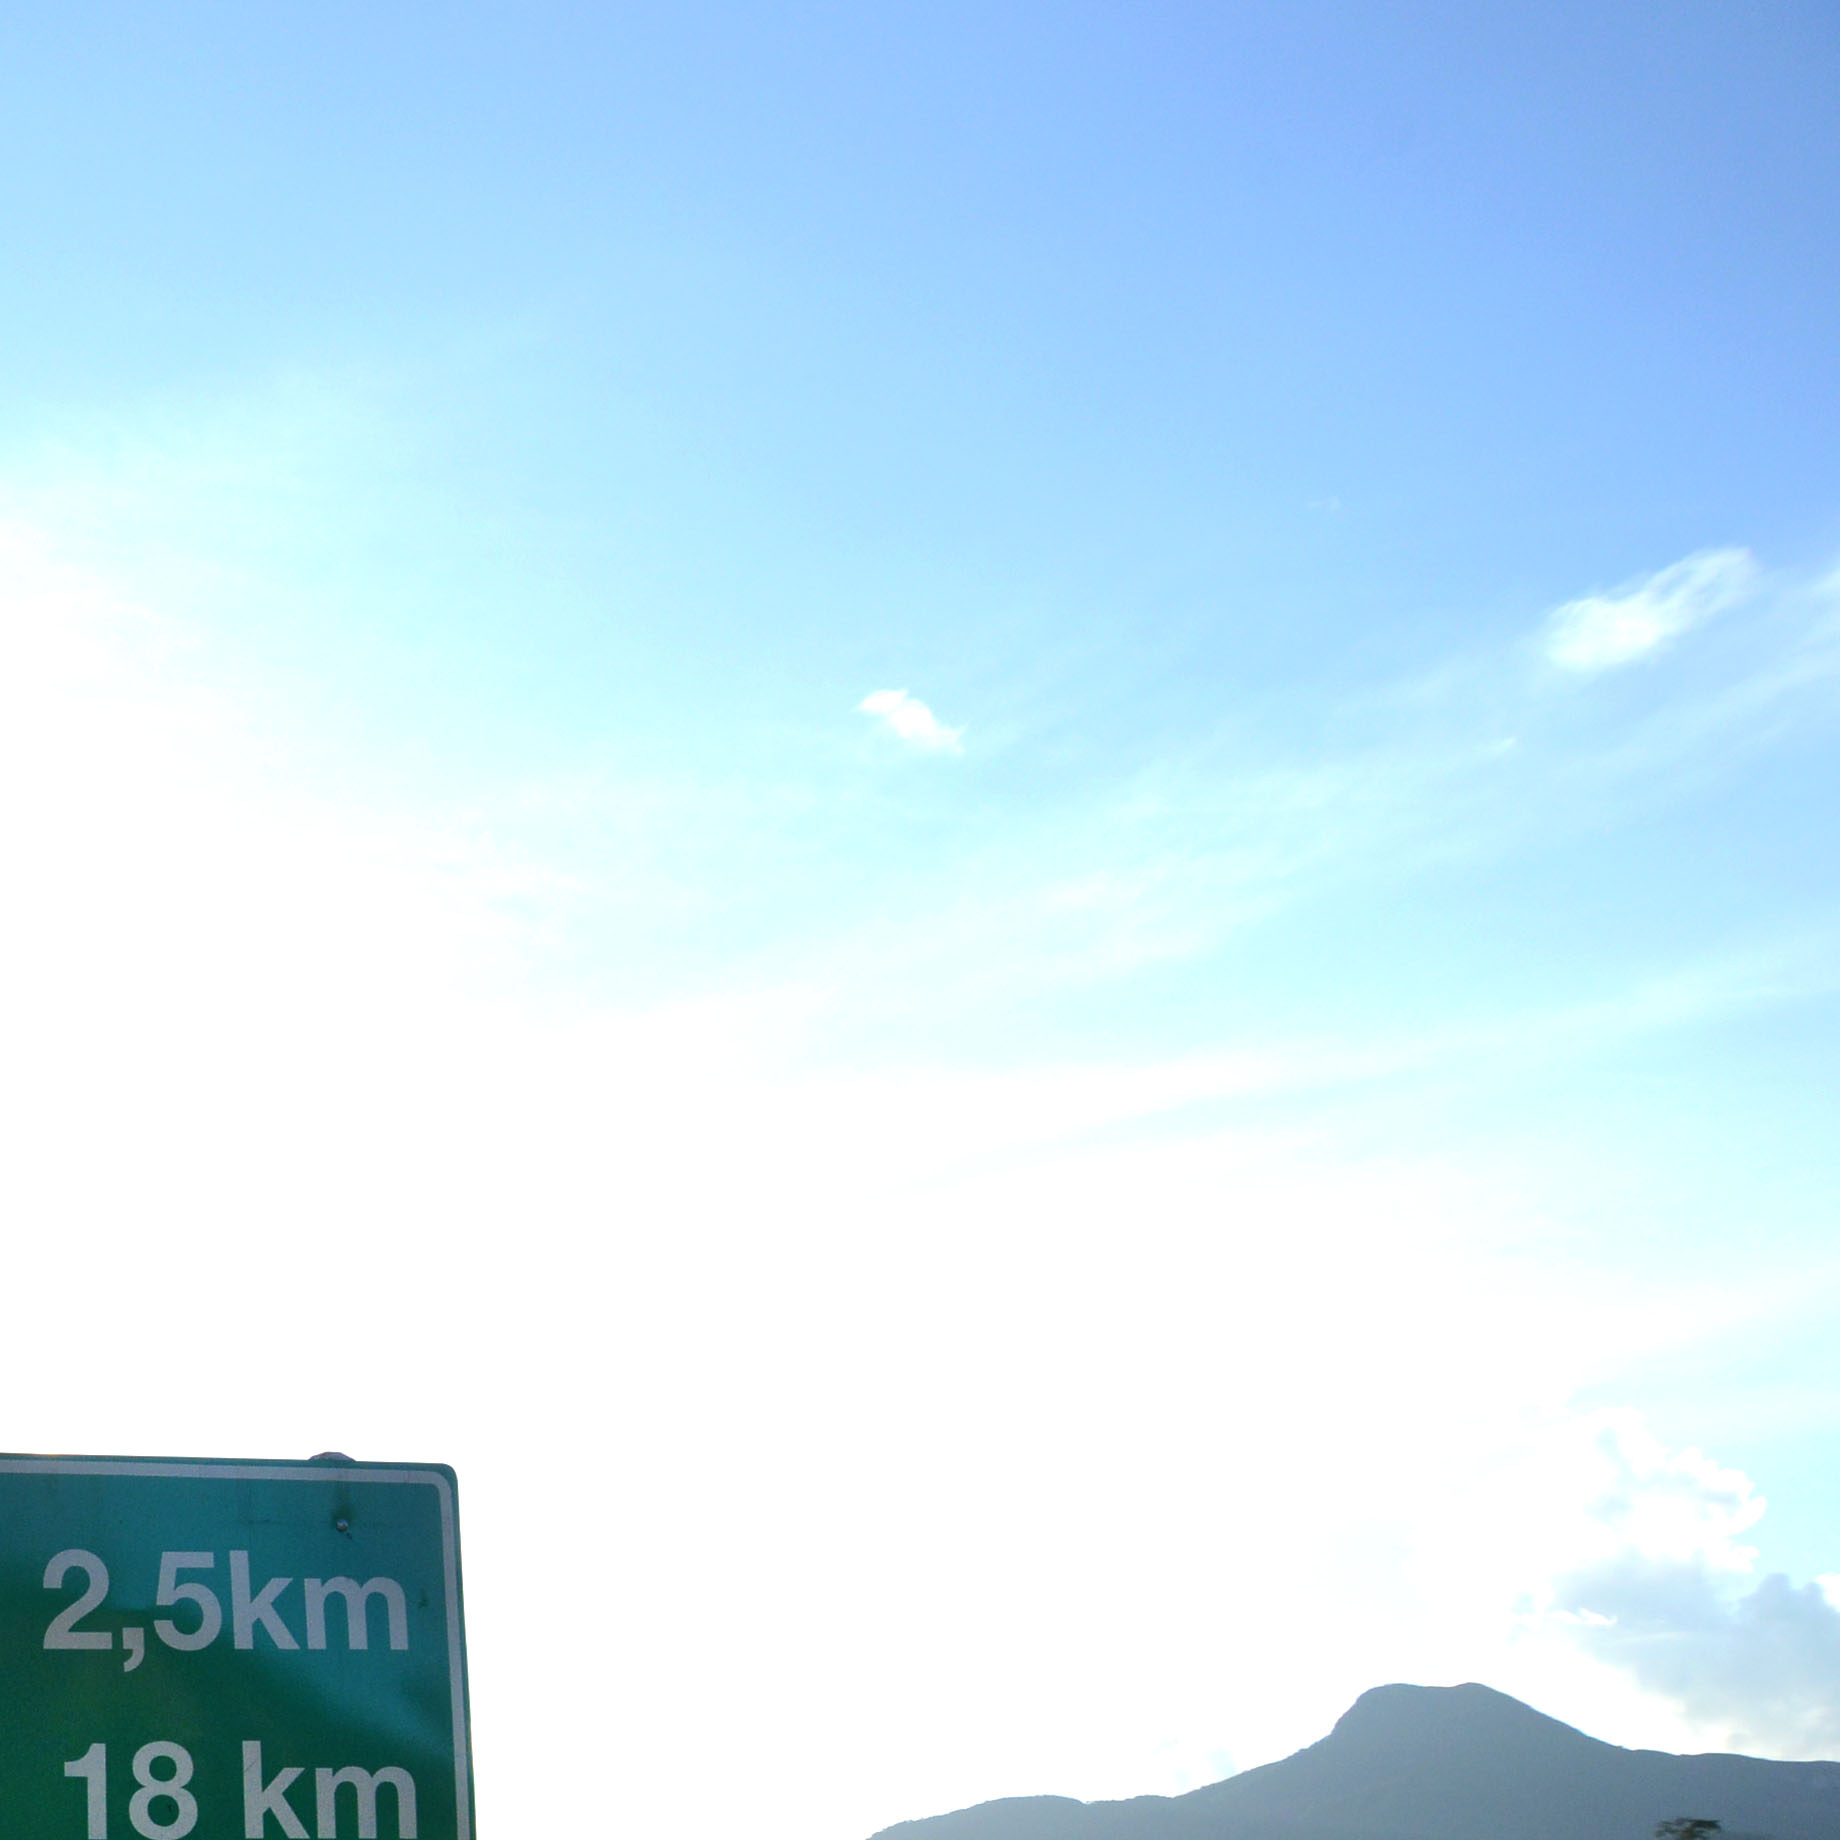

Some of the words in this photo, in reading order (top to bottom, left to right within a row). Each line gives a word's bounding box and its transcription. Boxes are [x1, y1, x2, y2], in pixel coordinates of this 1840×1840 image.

[42, 1548, 410, 1673] 2,5km
[65, 1742, 197, 1840] 18
[243, 1740, 419, 1840] km
